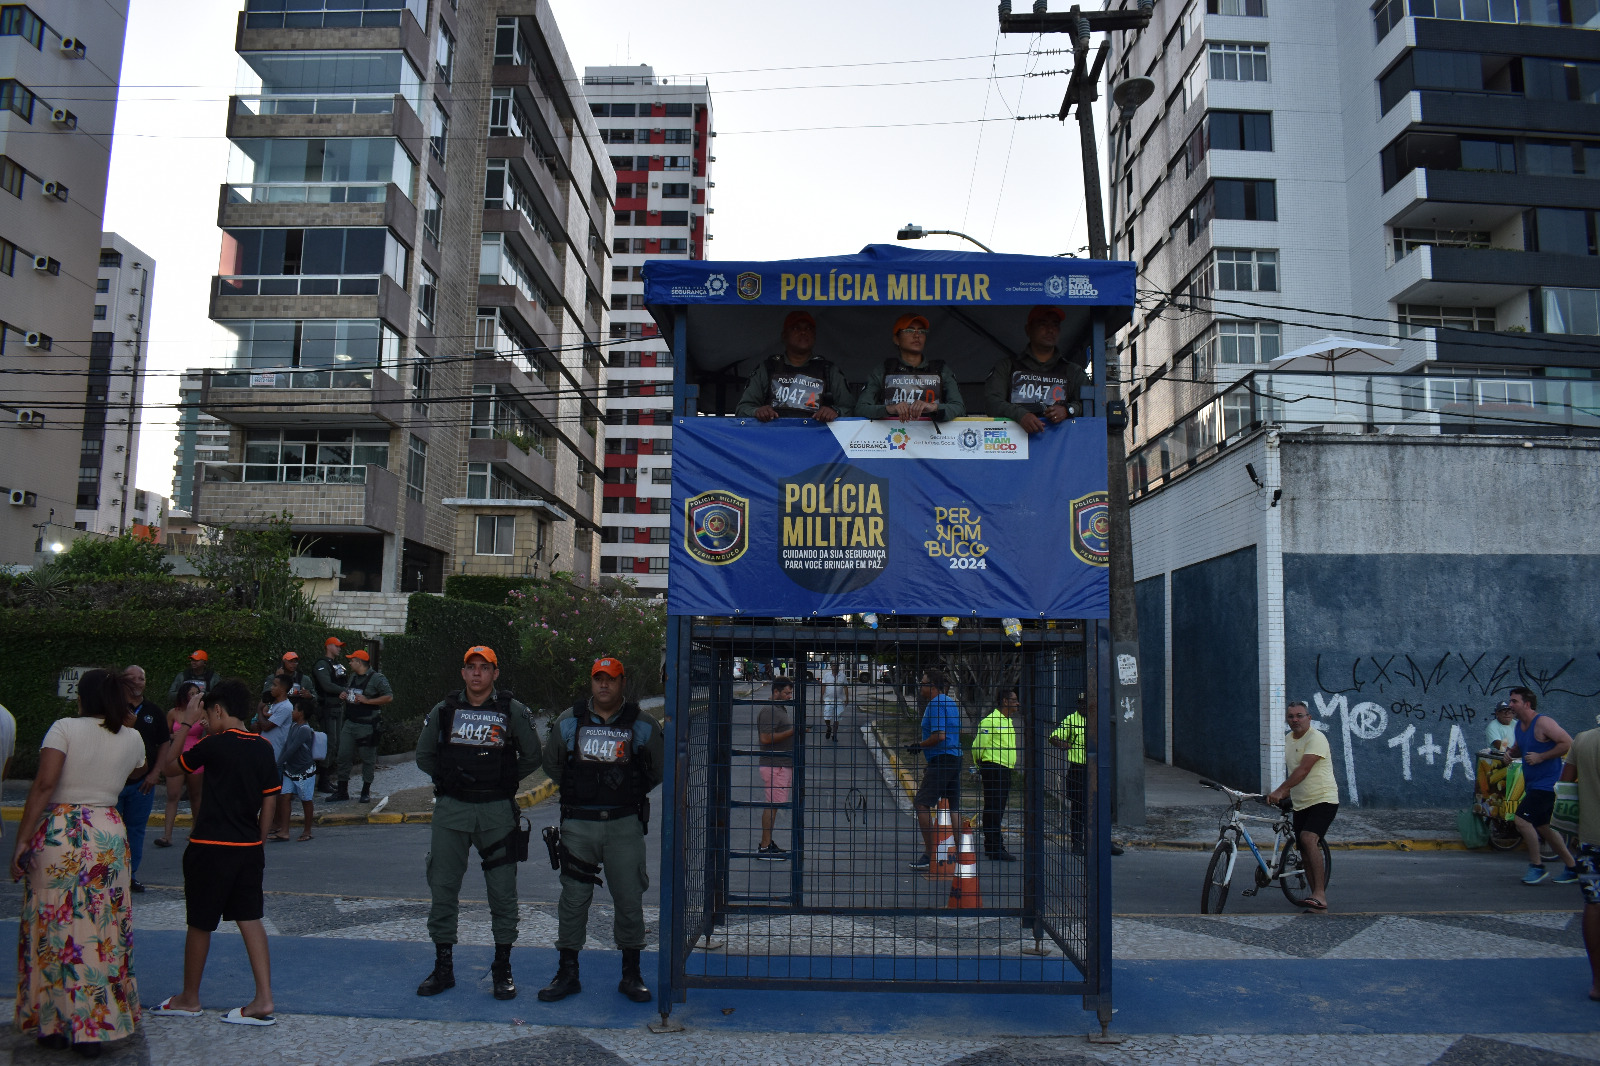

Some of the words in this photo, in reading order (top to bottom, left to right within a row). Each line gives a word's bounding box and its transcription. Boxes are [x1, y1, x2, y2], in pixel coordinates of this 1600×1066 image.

[780, 268, 880, 302] POLÍCIA
[887, 273, 992, 302] MILITAR
[983, 430, 1008, 438] PER
[849, 443, 888, 451] SEGURANÇA
[984, 443, 1017, 451] BUCO
[785, 477, 884, 515] POLÍCIA
[934, 506, 982, 525] PER
[782, 516, 886, 548] MILITAR
[782, 549, 818, 559] CUIDANDO
[819, 549, 828, 559] DA
[829, 549, 844, 559] SUA
[844, 549, 886, 561] SEGURANÇA
[923, 540, 990, 558] BUCO
[784, 560, 803, 569] PARA
[804, 558, 823, 570] VOCÊ
[824, 560, 855, 570] BRINCAR
[855, 560, 867, 569] EM
[867, 560, 884, 569] PAZ.
[949, 557, 987, 570] 2024
[60, 670, 79, 681] VILLA
